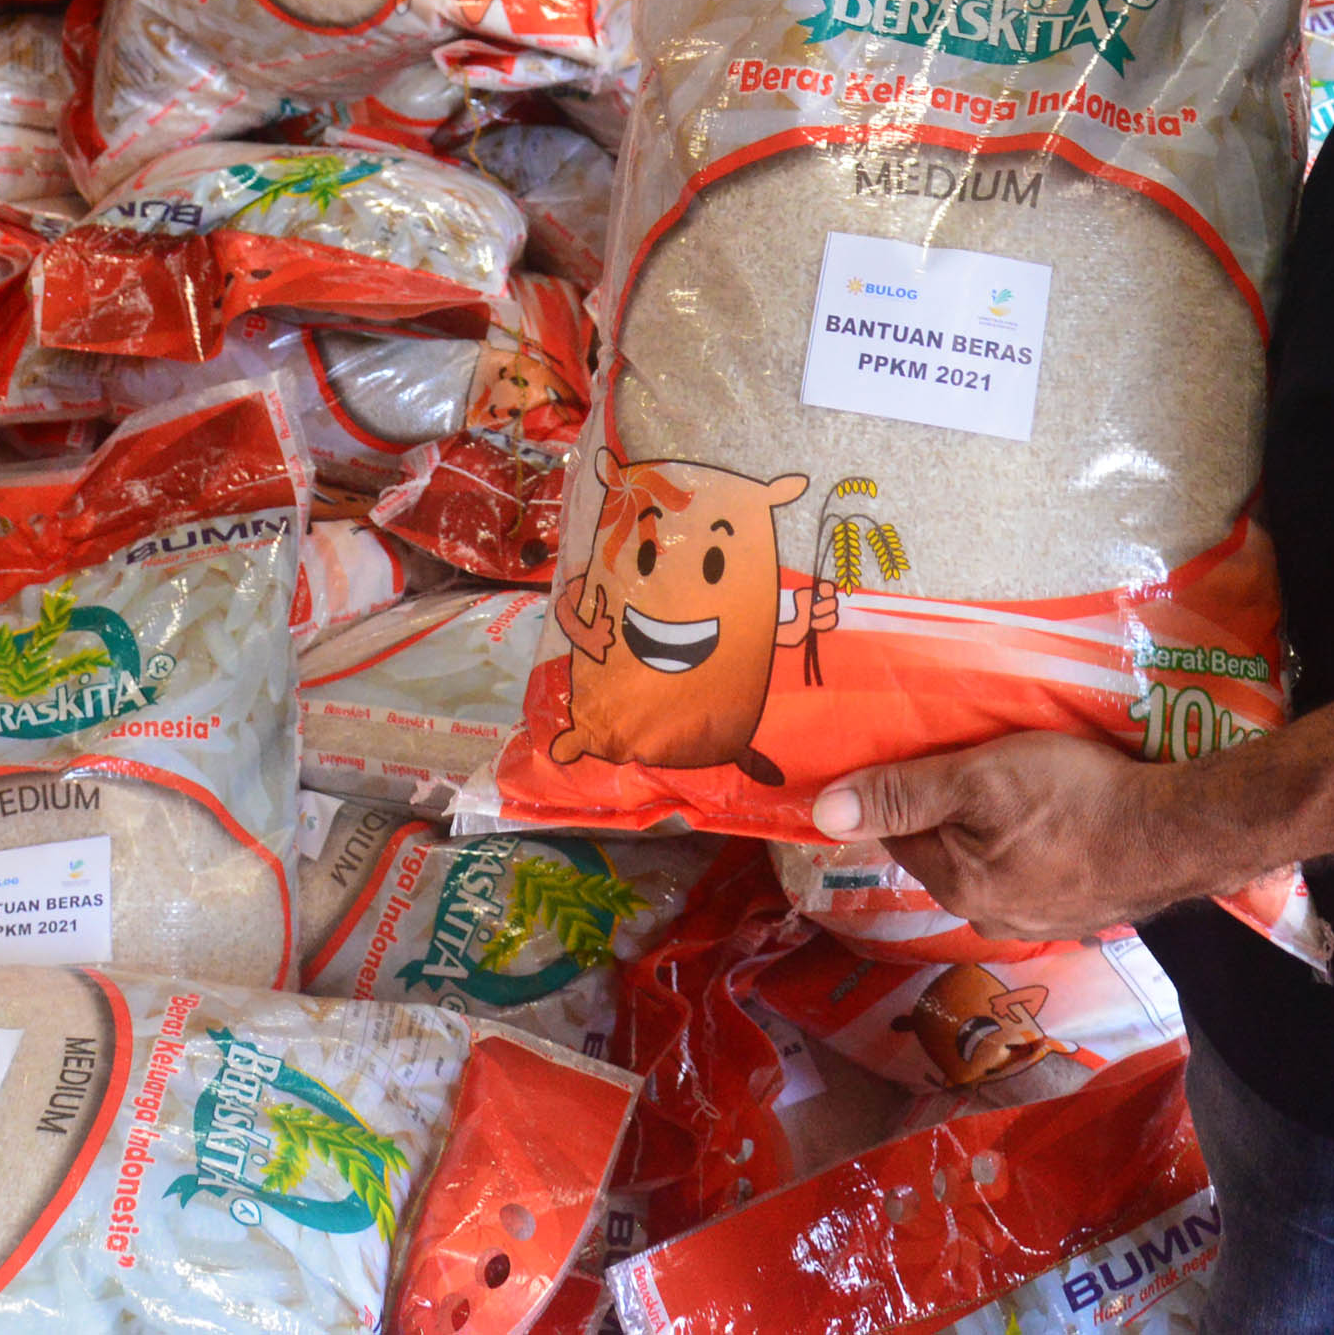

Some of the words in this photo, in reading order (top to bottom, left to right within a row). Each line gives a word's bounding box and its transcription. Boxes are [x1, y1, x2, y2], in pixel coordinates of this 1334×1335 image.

[855, 159, 1043, 210] MEDIUM
[865, 283, 918, 301] BULOG
[825, 315, 944, 349] BANTUAN
[951, 335, 1033, 365] BERAS
[858, 353, 927, 380] PPKM
[935, 365, 992, 392] 2021
[125, 515, 292, 568] BUMN
[1210, 647, 1270, 683] Bersih
[1129, 682, 1269, 763] 10k
[331, 809, 389, 888] DIUM
[37, 919, 78, 934] 2021
[46, 893, 104, 910] BERAS
[35, 1036, 97, 1135] MEDIUM
[133, 1038, 186, 1125] Keluarga
[1063, 1205, 1222, 1313] BUMN
